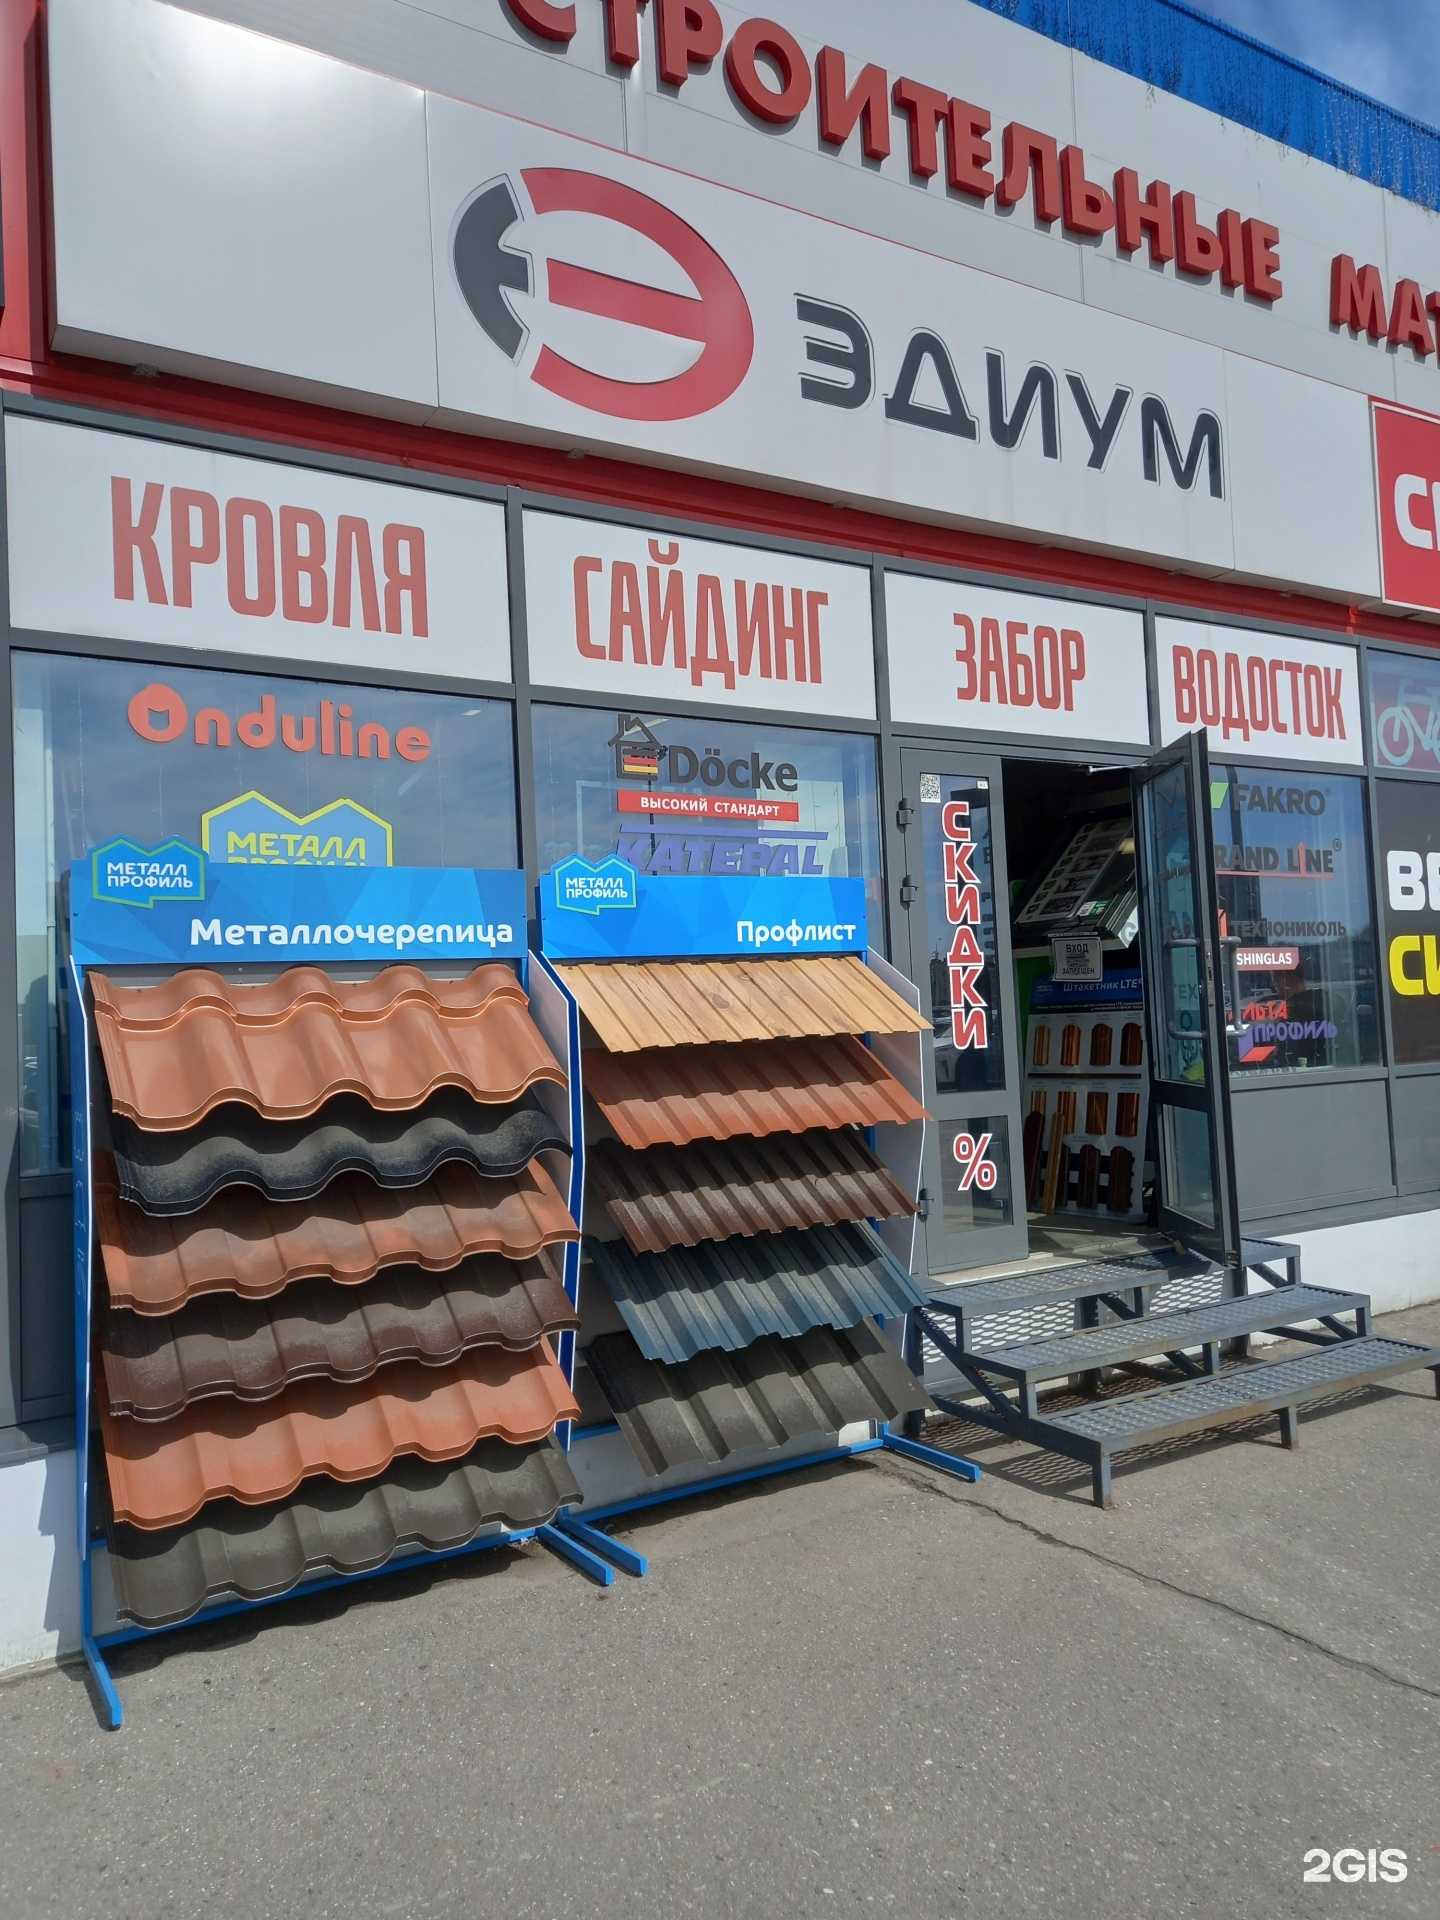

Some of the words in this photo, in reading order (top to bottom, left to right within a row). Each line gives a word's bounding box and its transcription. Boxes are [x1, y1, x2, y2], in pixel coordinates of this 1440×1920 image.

[794, 293, 1225, 500] ЭДИУМ
[1394, 473, 1440, 551] С
[111, 475, 429, 639] КРОВЛЯ
[573, 538, 829, 690] САЙДИНГ
[954, 612, 1087, 711] ЗАБОР
[1172, 644, 1347, 741] ВОДОСТОК
[127, 683, 433, 763] Onduline
[668, 745, 799, 792] Döcke
[640, 797, 708, 812] ВЫСОКИЙ
[713, 801, 780, 817] СТАНДАРТ
[227, 831, 367, 861] МЕТАЛЛ
[1214, 843, 1279, 870] RAND
[106, 862, 188, 876] МЕТАЛЛ
[106, 875, 193, 888] ПРОФИЛЬ
[565, 877, 624, 888] МЕТАЛЛ
[566, 888, 628, 898] ПРОФИЛЬ
[190, 918, 514, 951] Металлочерепица
[736, 919, 857, 947] Профлист
[941, 800, 989, 1050] СКИДКИ
[1231, 921, 1346, 937] ТЕХНОНИКОЛЬ
[1236, 953, 1293, 965] SHINGLAS
